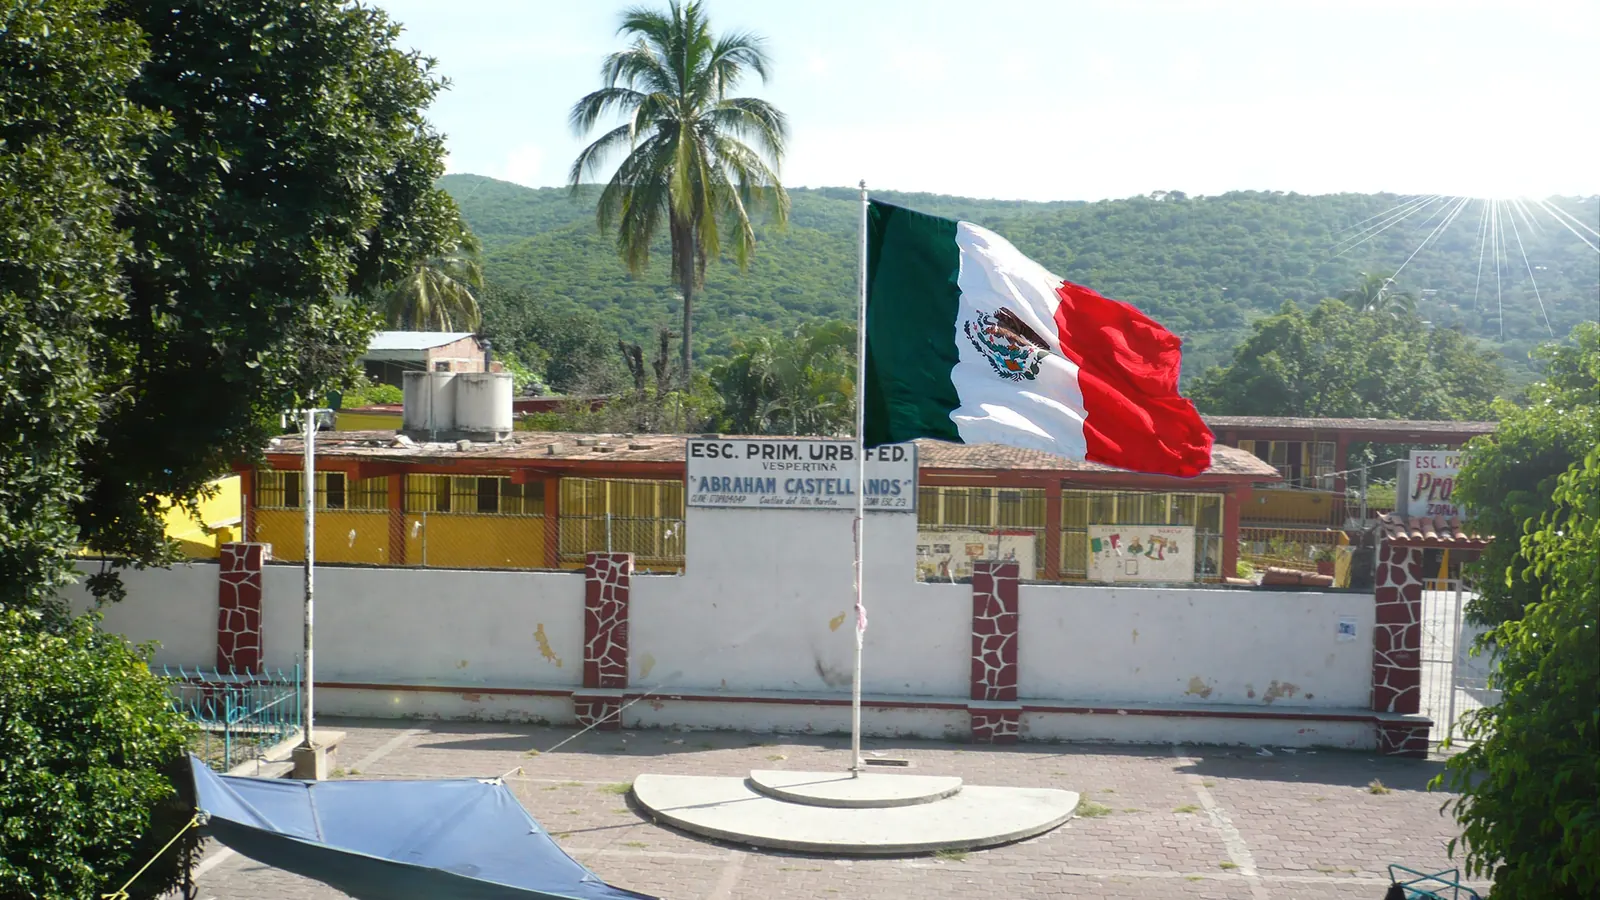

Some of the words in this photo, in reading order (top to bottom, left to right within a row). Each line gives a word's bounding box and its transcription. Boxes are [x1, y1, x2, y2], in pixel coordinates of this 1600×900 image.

[691, 443, 739, 459] ESC.
[746, 444, 802, 460] PRIM.
[809, 445, 857, 461] URB.
[865, 446, 908, 462] FED.
[762, 462, 837, 472] VESPERTINA
[1416, 456, 1441, 469] ESC.
[1427, 503, 1458, 516] ZONA
